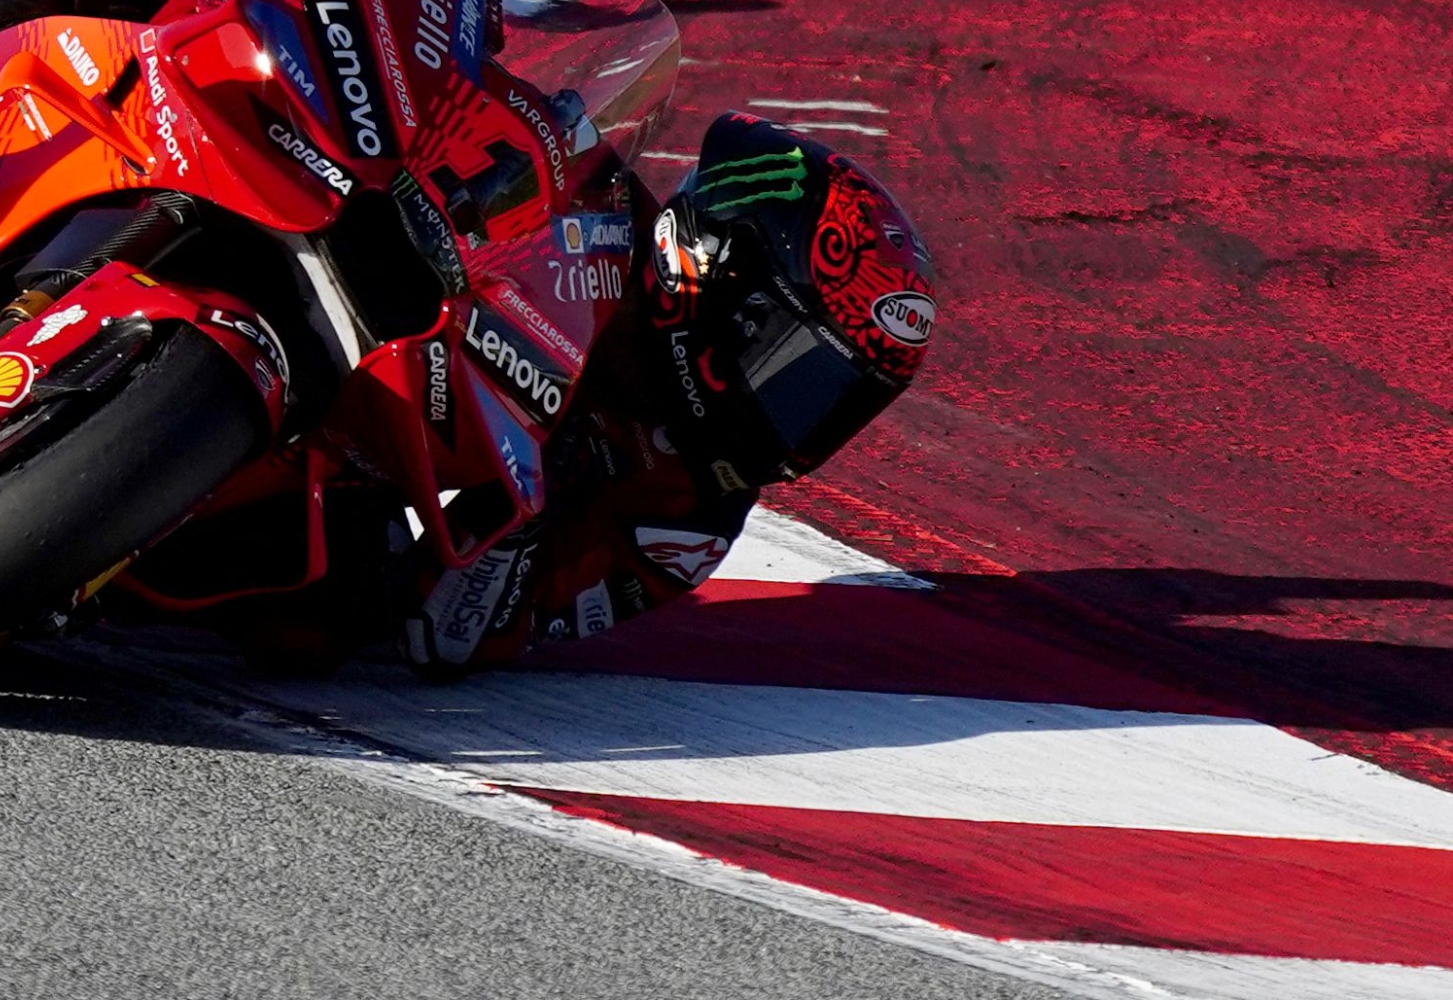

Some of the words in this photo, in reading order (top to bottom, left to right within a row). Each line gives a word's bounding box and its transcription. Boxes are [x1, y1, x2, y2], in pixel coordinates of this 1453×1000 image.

[145, 55, 168, 103] Audi
[276, 47, 315, 98] TIM
[315, 1, 382, 158] Lenovo
[155, 104, 190, 177] Sport
[268, 123, 354, 196] CARRERA
[507, 88, 566, 192] VARGROUP
[413, 193, 466, 294] MONSTER
[589, 216, 631, 247] ADVANCE
[465, 308, 563, 415] Lenovo
[503, 289, 585, 364] FRECCIAROSSA
[817, 326, 854, 361] CARRERA
[429, 341, 447, 422] CARRERA
[671, 330, 705, 418] Lenovo
[500, 436, 525, 491] TIM
